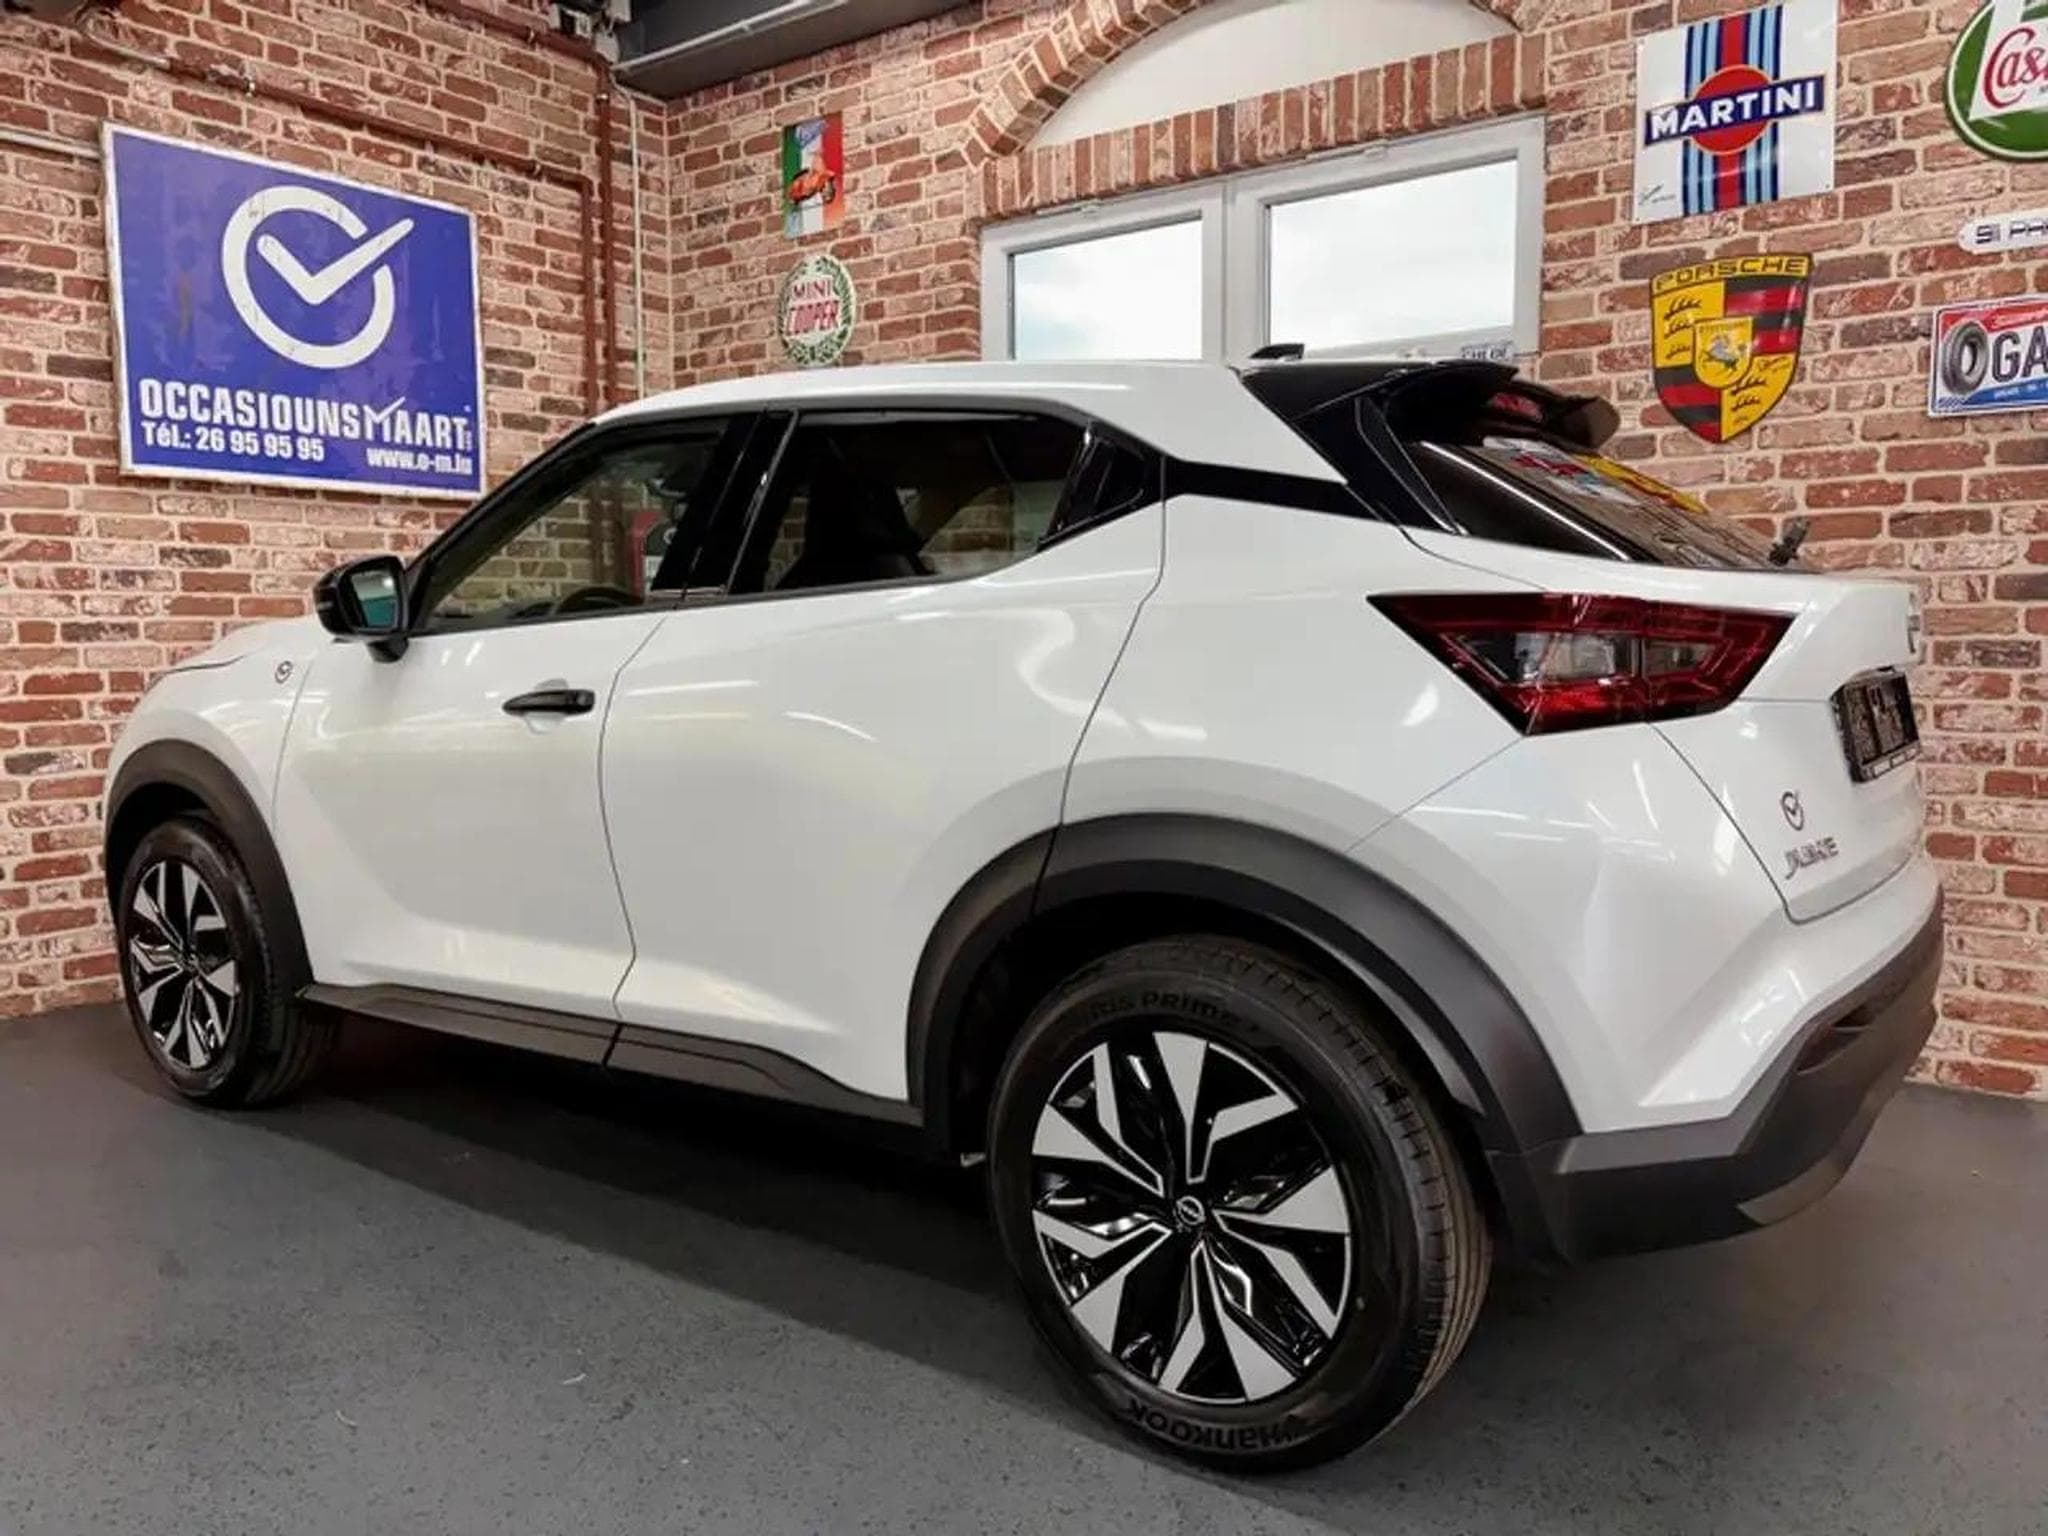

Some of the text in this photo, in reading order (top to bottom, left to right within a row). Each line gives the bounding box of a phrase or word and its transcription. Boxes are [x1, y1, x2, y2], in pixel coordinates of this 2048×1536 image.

[1984, 27, 2048, 109] Cas
[1651, 82, 1815, 140] MARTINI
[1656, 257, 1806, 291] PORSCHE
[141, 419, 325, 463] Tél.: 26 95 95 95
